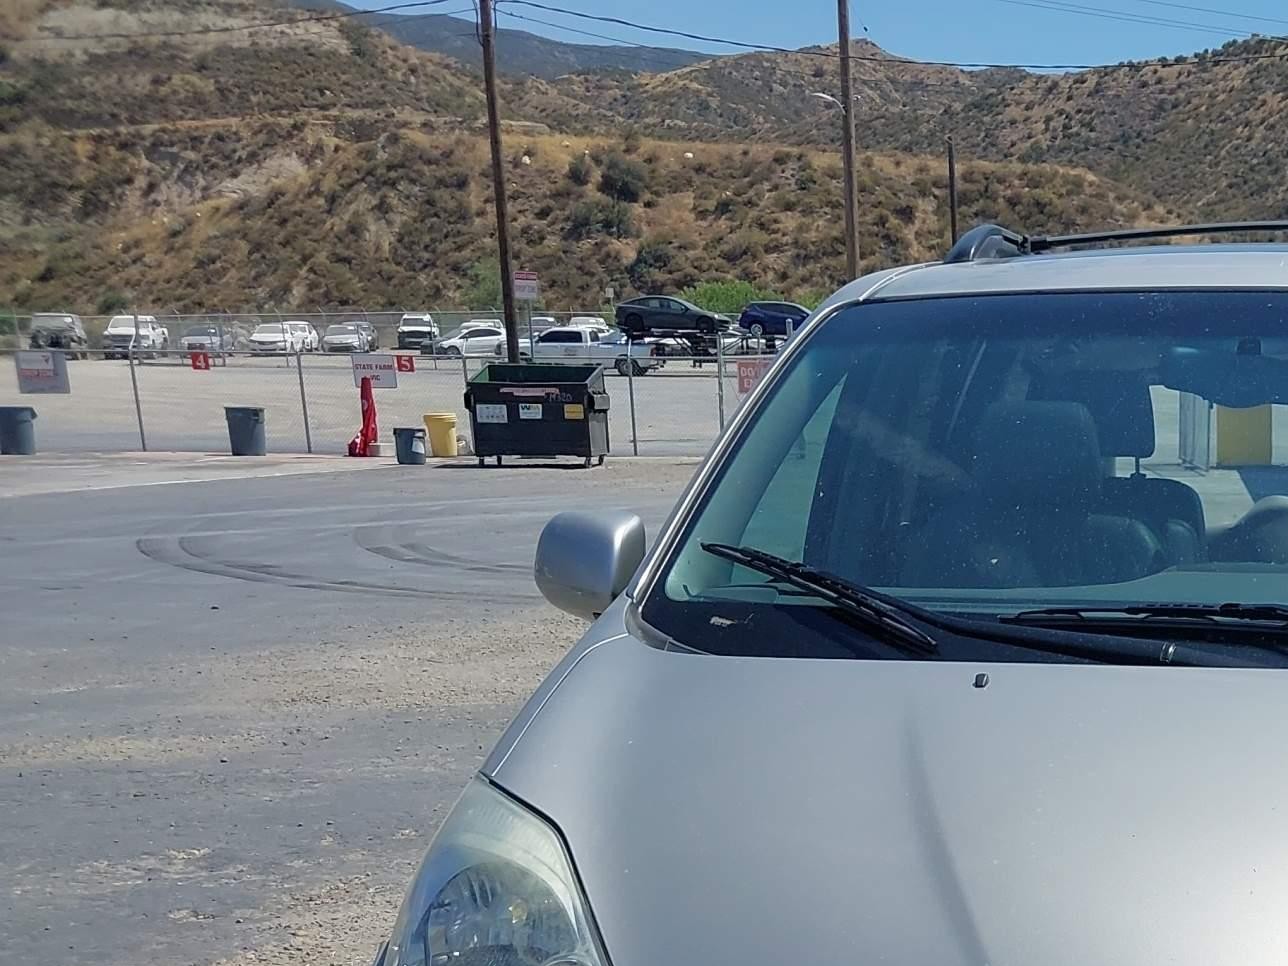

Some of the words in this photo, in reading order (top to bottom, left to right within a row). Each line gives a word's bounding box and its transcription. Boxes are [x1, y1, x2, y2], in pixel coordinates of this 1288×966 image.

[195, 353, 206, 369] 4
[355, 363, 373, 371] STATE
[401, 357, 411, 371] 5
